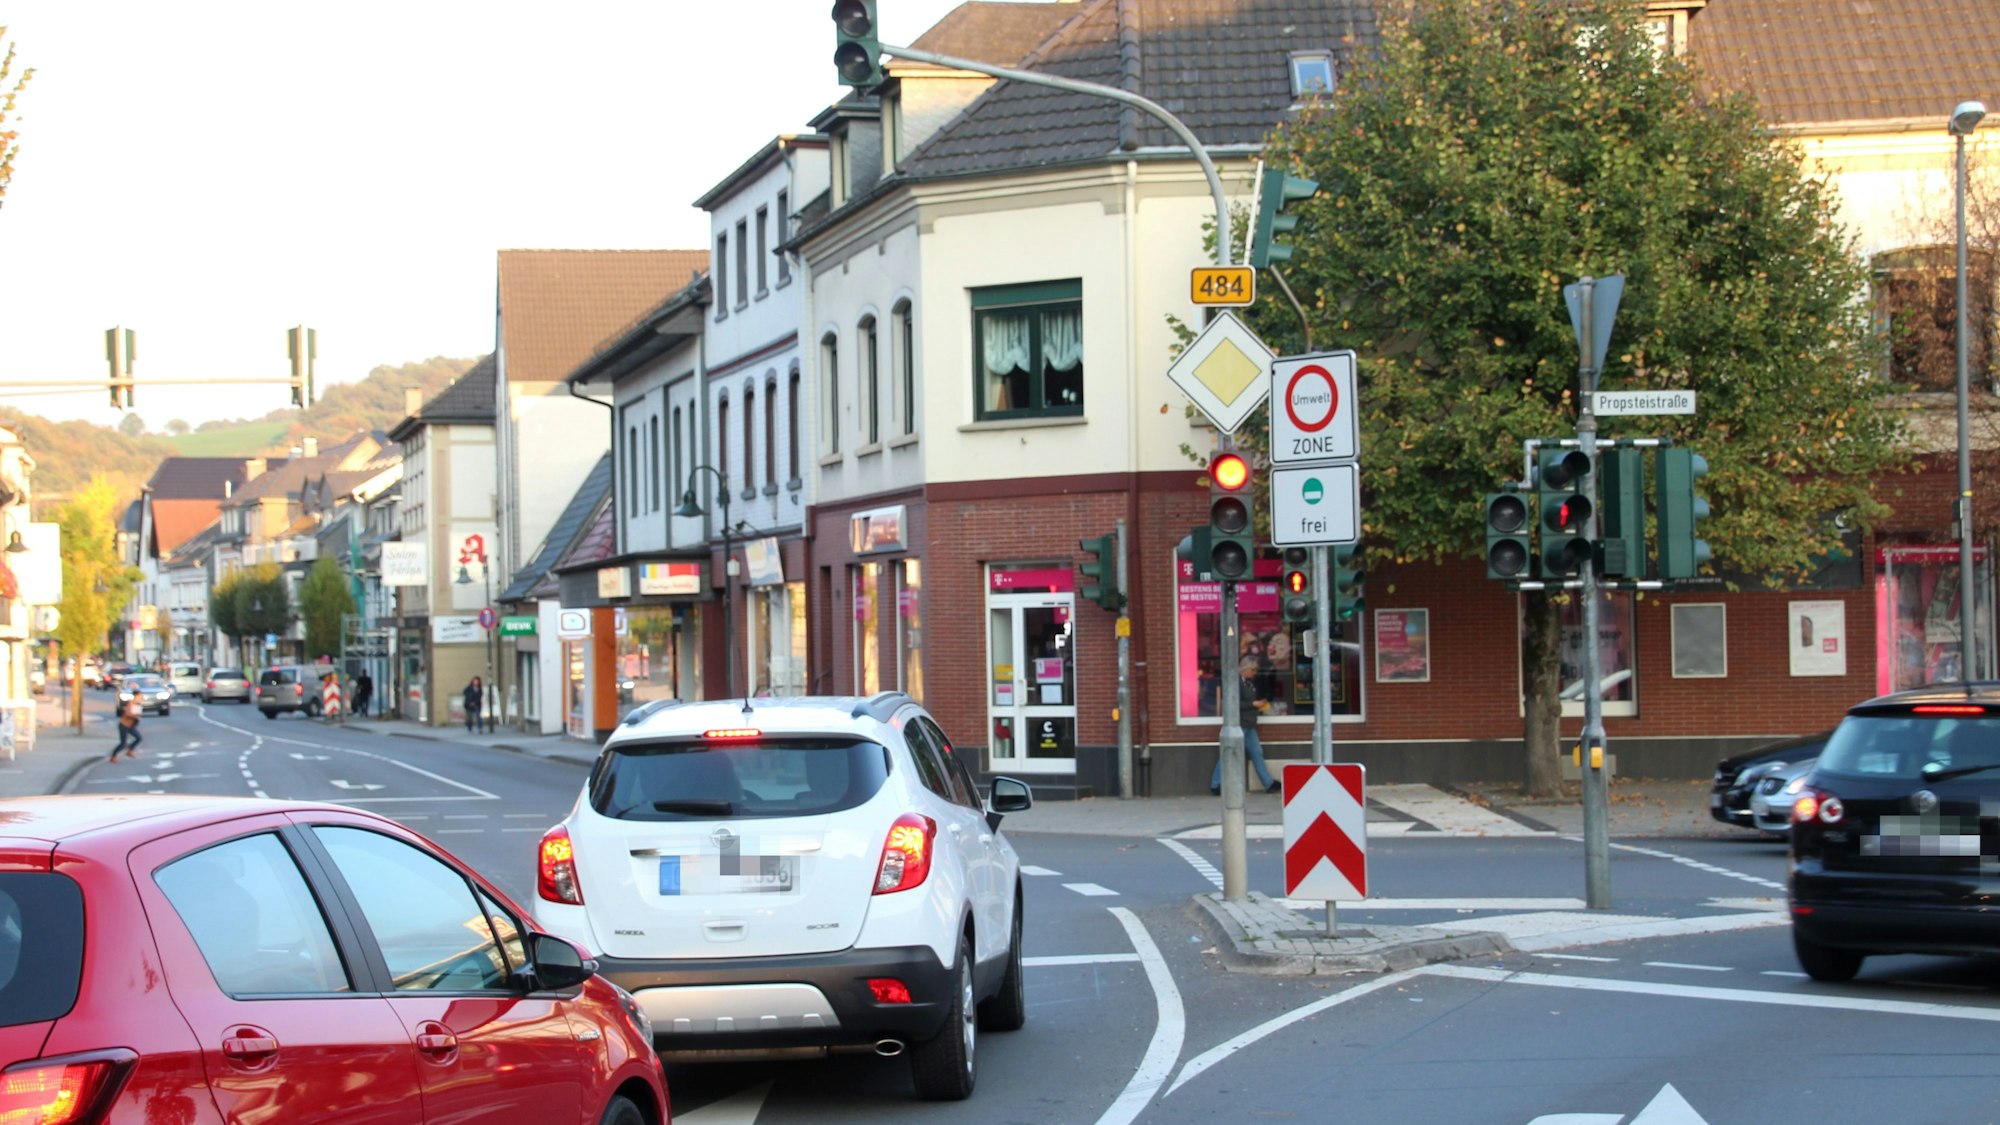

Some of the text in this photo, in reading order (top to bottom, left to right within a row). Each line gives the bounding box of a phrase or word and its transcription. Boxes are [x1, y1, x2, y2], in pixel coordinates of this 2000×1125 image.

[1200, 275, 1244, 297] 484
[1292, 391, 1331, 406] Umwelt
[1600, 394, 1688, 412] Propsteistraße
[1292, 436, 1334, 455] ZONE
[1301, 516, 1327, 534] frei
